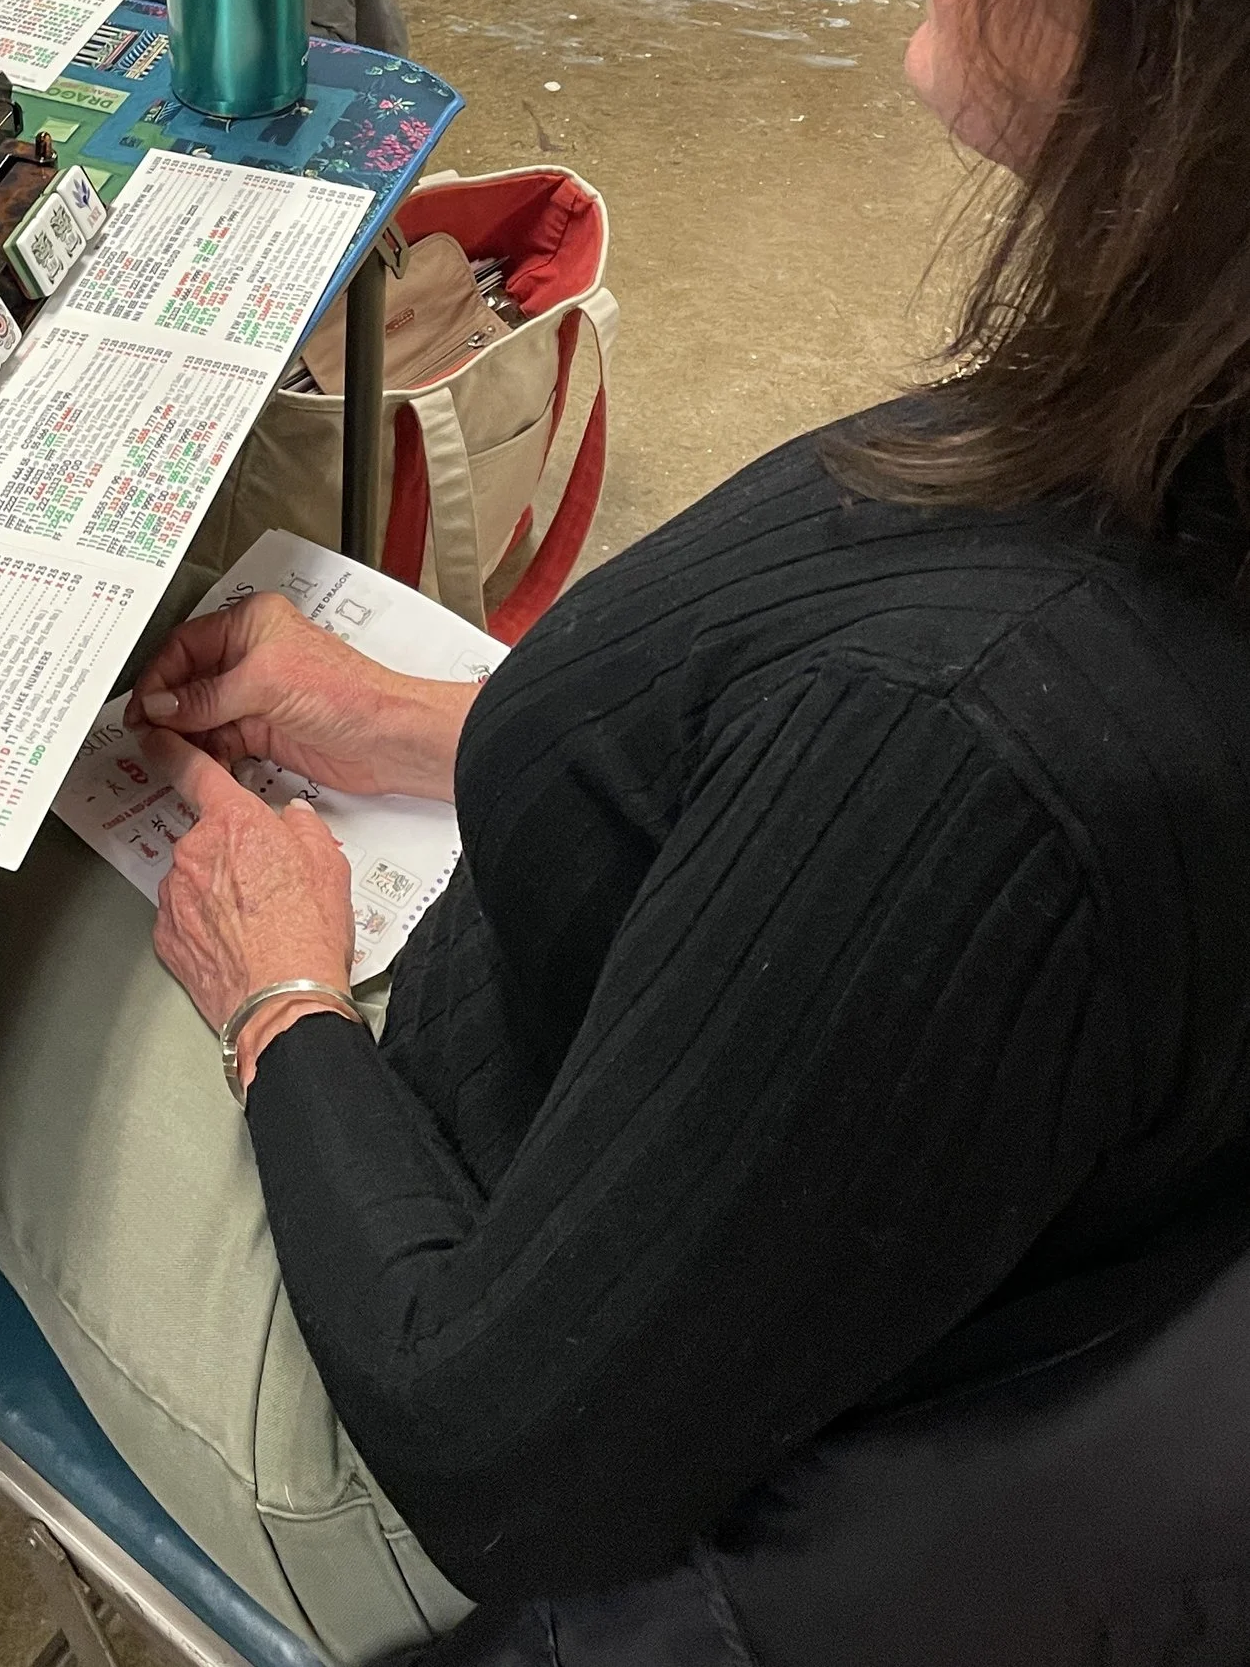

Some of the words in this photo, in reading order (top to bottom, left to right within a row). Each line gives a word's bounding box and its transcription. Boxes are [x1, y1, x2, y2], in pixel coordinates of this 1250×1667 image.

[308, 601, 326, 622] HITE
[321, 568, 352, 606] DRAGON
[0, 712, 15, 732] ANY
[11, 691, 28, 710] LIKE
[24, 651, 52, 689] NUMBERS
